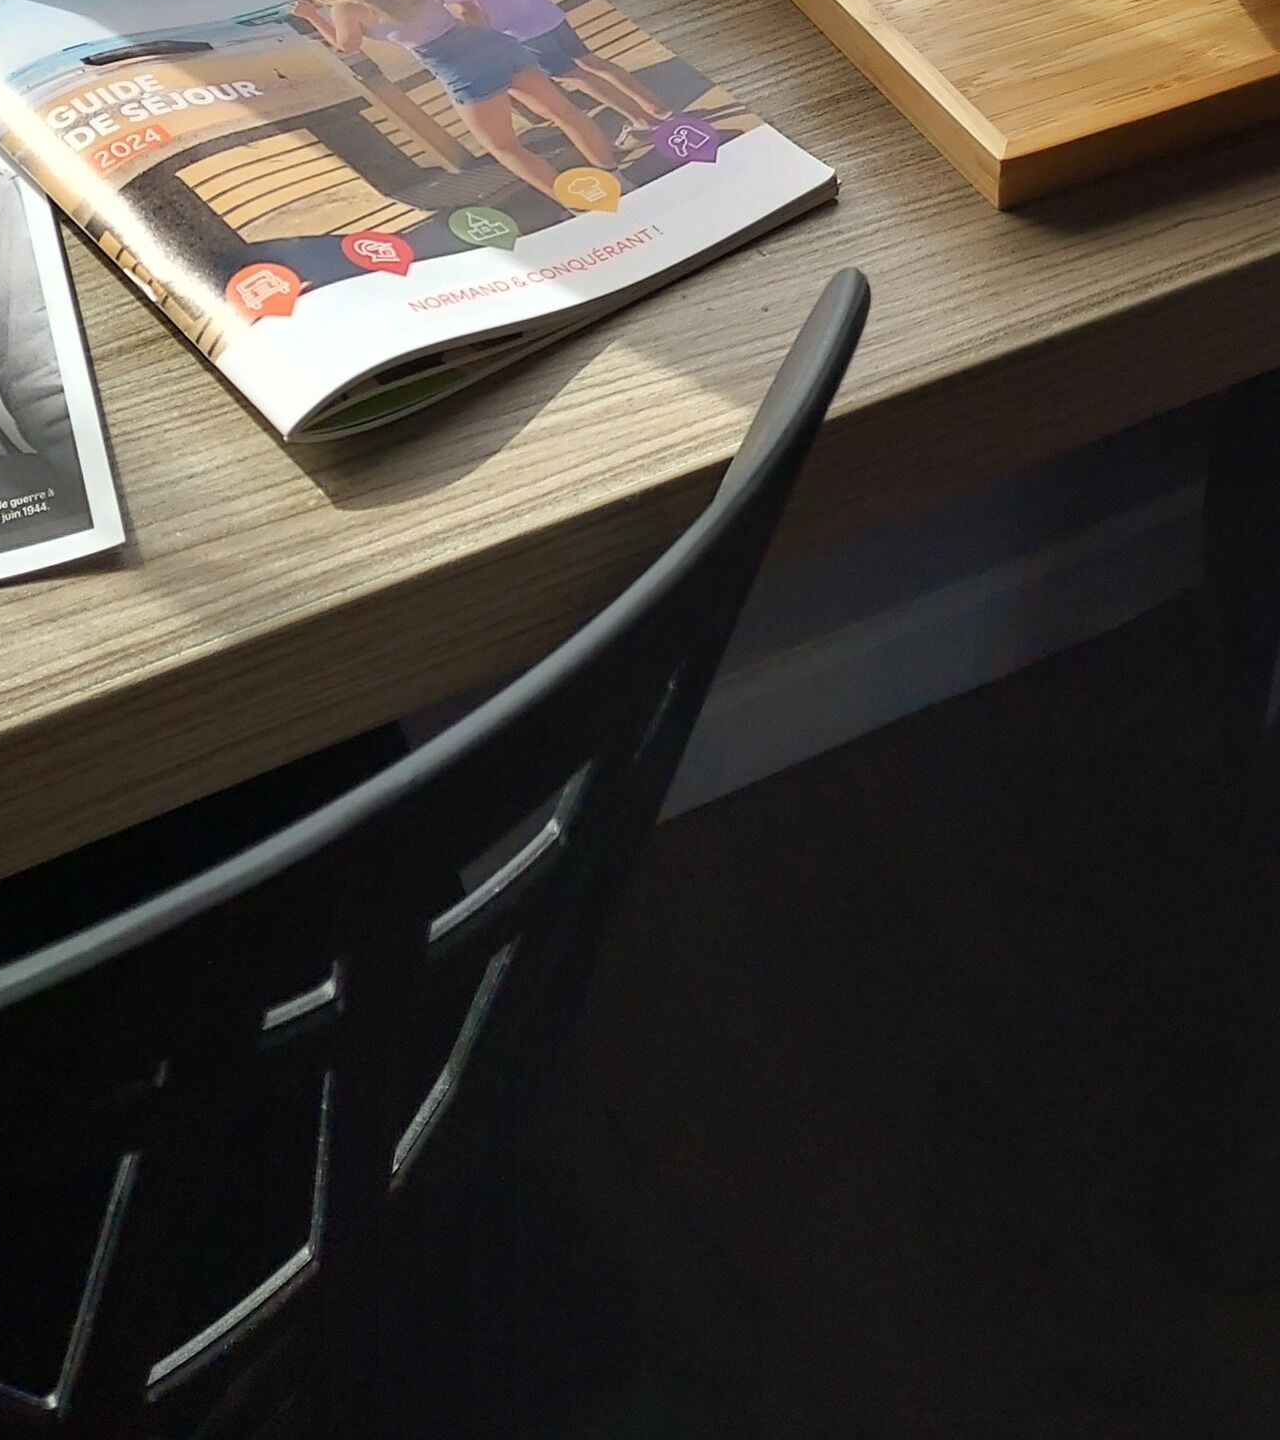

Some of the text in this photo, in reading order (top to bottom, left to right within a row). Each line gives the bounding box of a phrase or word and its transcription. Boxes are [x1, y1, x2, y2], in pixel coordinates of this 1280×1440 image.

[46, 73, 166, 130] GUIDE
[63, 81, 265, 152] DE SÉJOUR
[94, 127, 163, 170] 2024
[407, 279, 510, 313] NORMAND
[510, 276, 527, 289] &
[526, 228, 654, 284] CONQUÉRANT
[1, 509, 21, 524] juin
[9, 491, 47, 509] guerre
